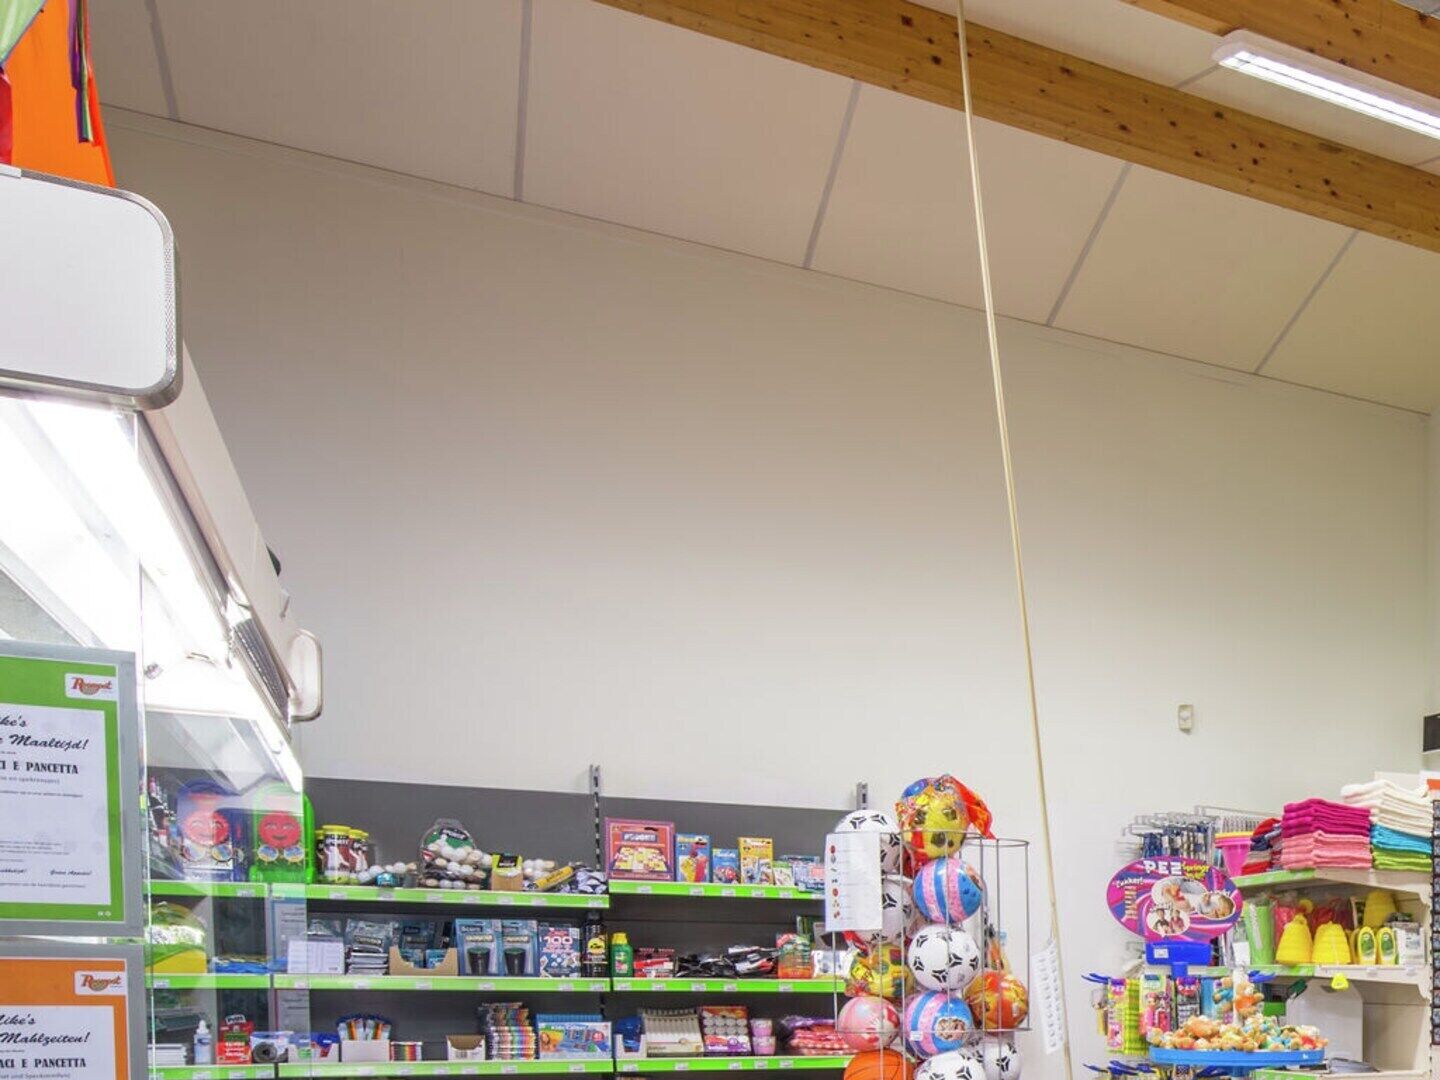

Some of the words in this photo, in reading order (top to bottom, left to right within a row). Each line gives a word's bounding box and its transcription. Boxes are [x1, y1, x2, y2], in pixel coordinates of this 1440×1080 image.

[9, 734, 90, 752] Maaltijd!
[13, 760, 20, 771] E
[26, 761, 79, 775] PANCETTA
[1143, 860, 1182, 875] PEZ
[22, 1058, 28, 1069] E
[34, 1057, 86, 1069] PANCETTA
